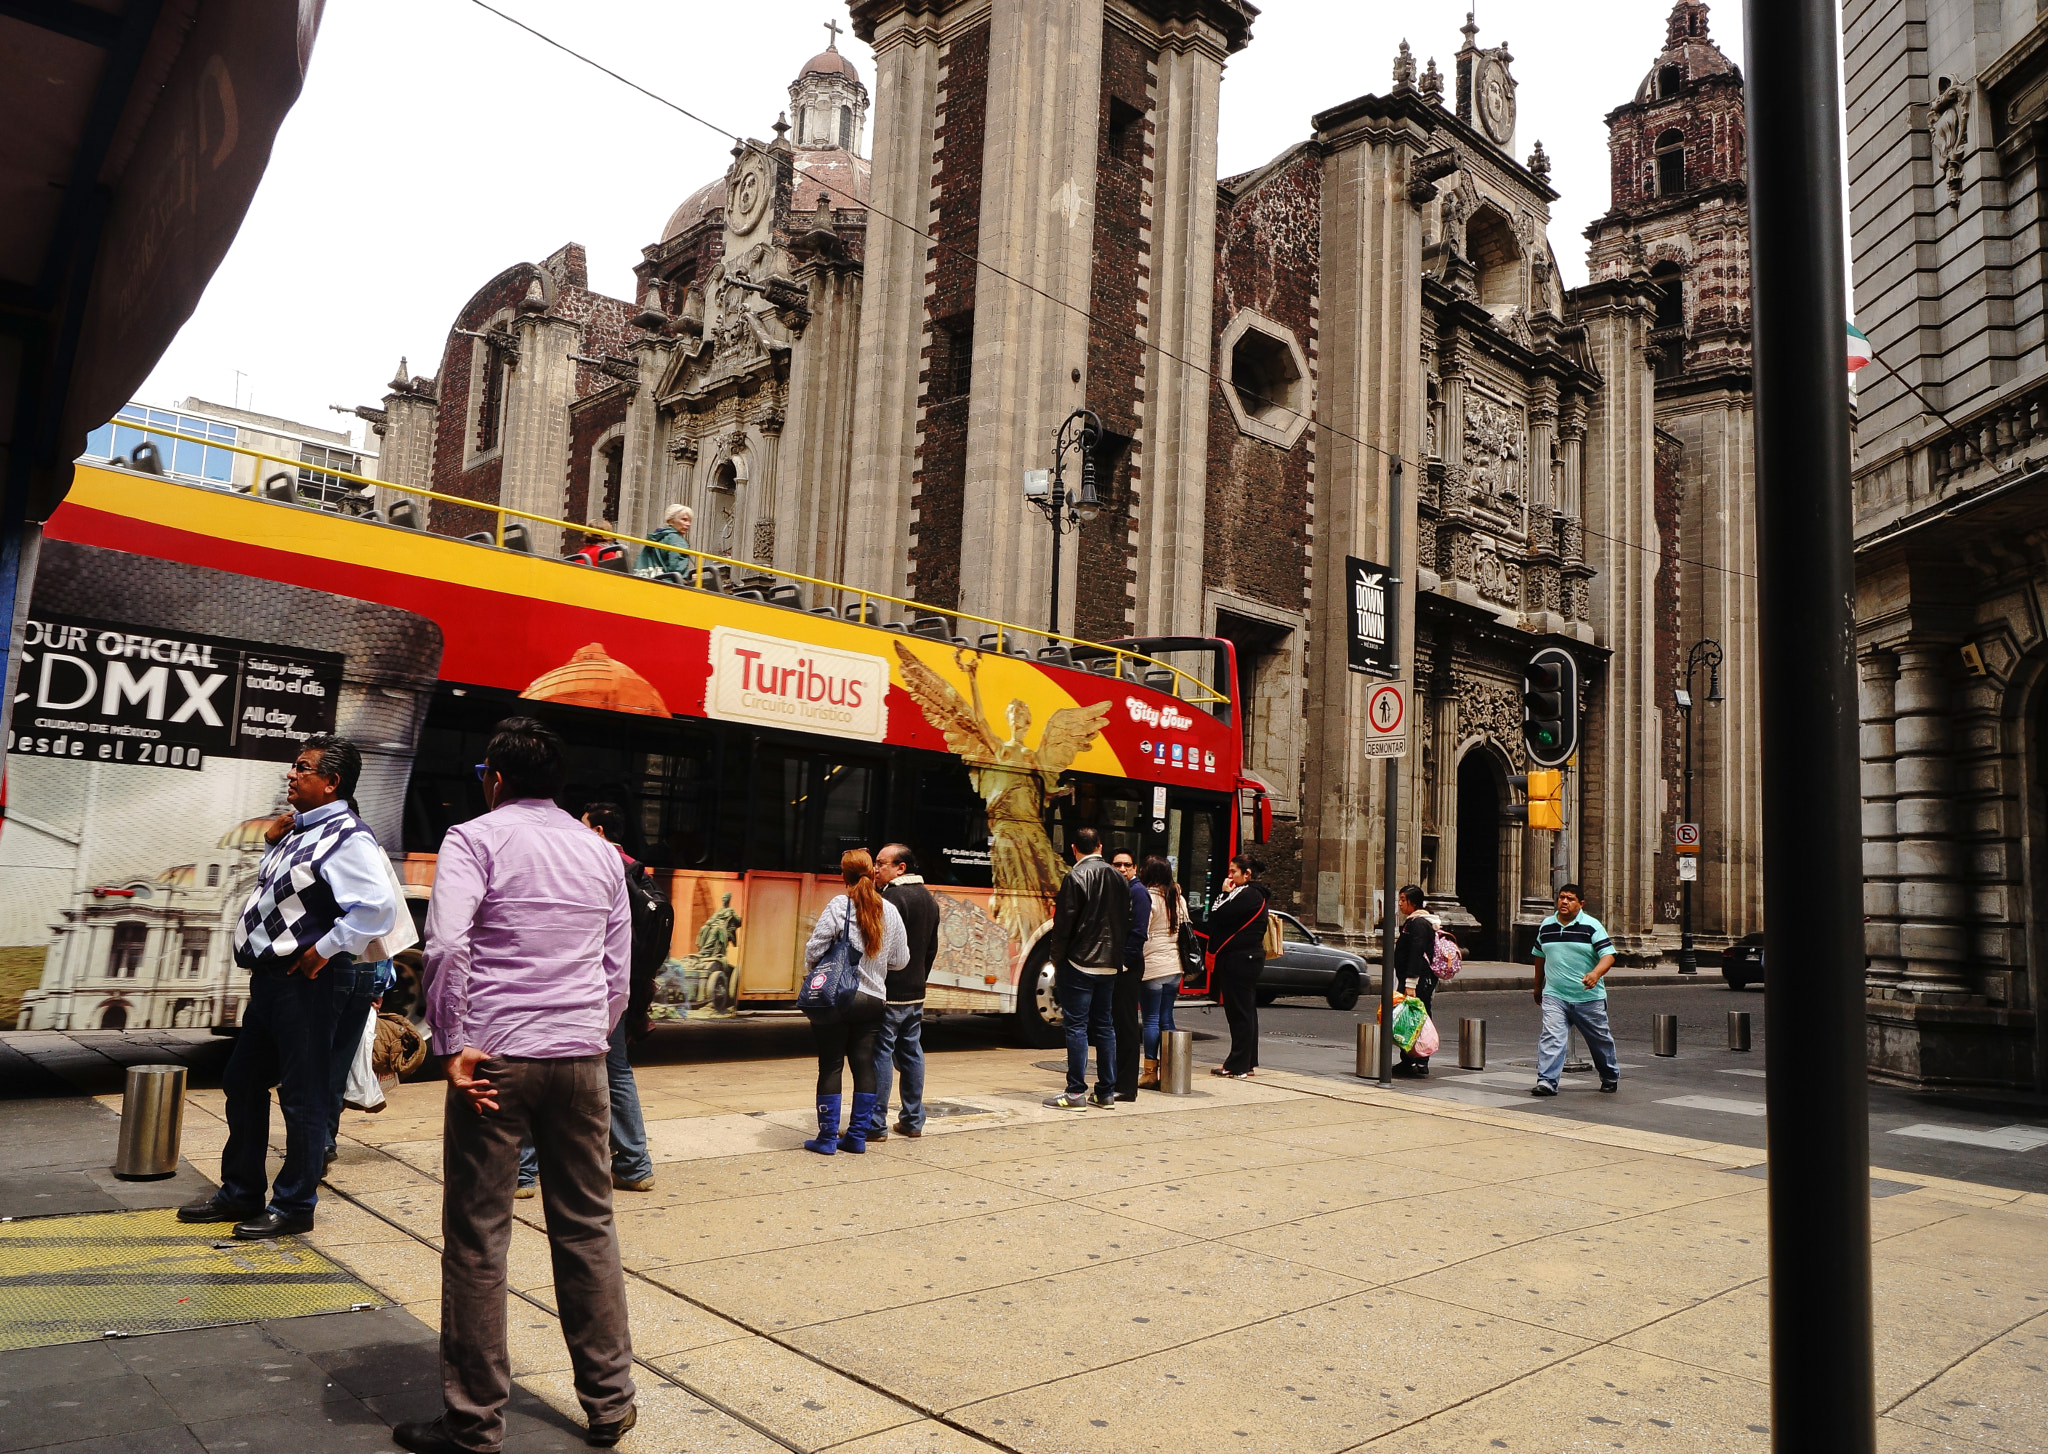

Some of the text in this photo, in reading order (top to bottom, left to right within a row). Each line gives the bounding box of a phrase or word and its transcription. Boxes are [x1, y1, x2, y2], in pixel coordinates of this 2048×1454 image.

[1356, 584, 1384, 615] DOWN
[1356, 609, 1384, 640] TOWN
[24, 620, 219, 669] OUR OFICIAL
[278, 665, 288, 676] y
[734, 648, 862, 708] Turibus
[246, 675, 325, 696] todo el día
[242, 706, 297, 728] All day
[741, 692, 852, 723] Circuito Turístico
[1125, 696, 1193, 729] City Tour
[34, 718, 162, 739] CIUDAD DE MÉXICO
[241, 722, 267, 738] hop
[98, 740, 124, 760] el
[138, 743, 200, 767] 2000
[1367, 741, 1404, 755] DESMONTAR
